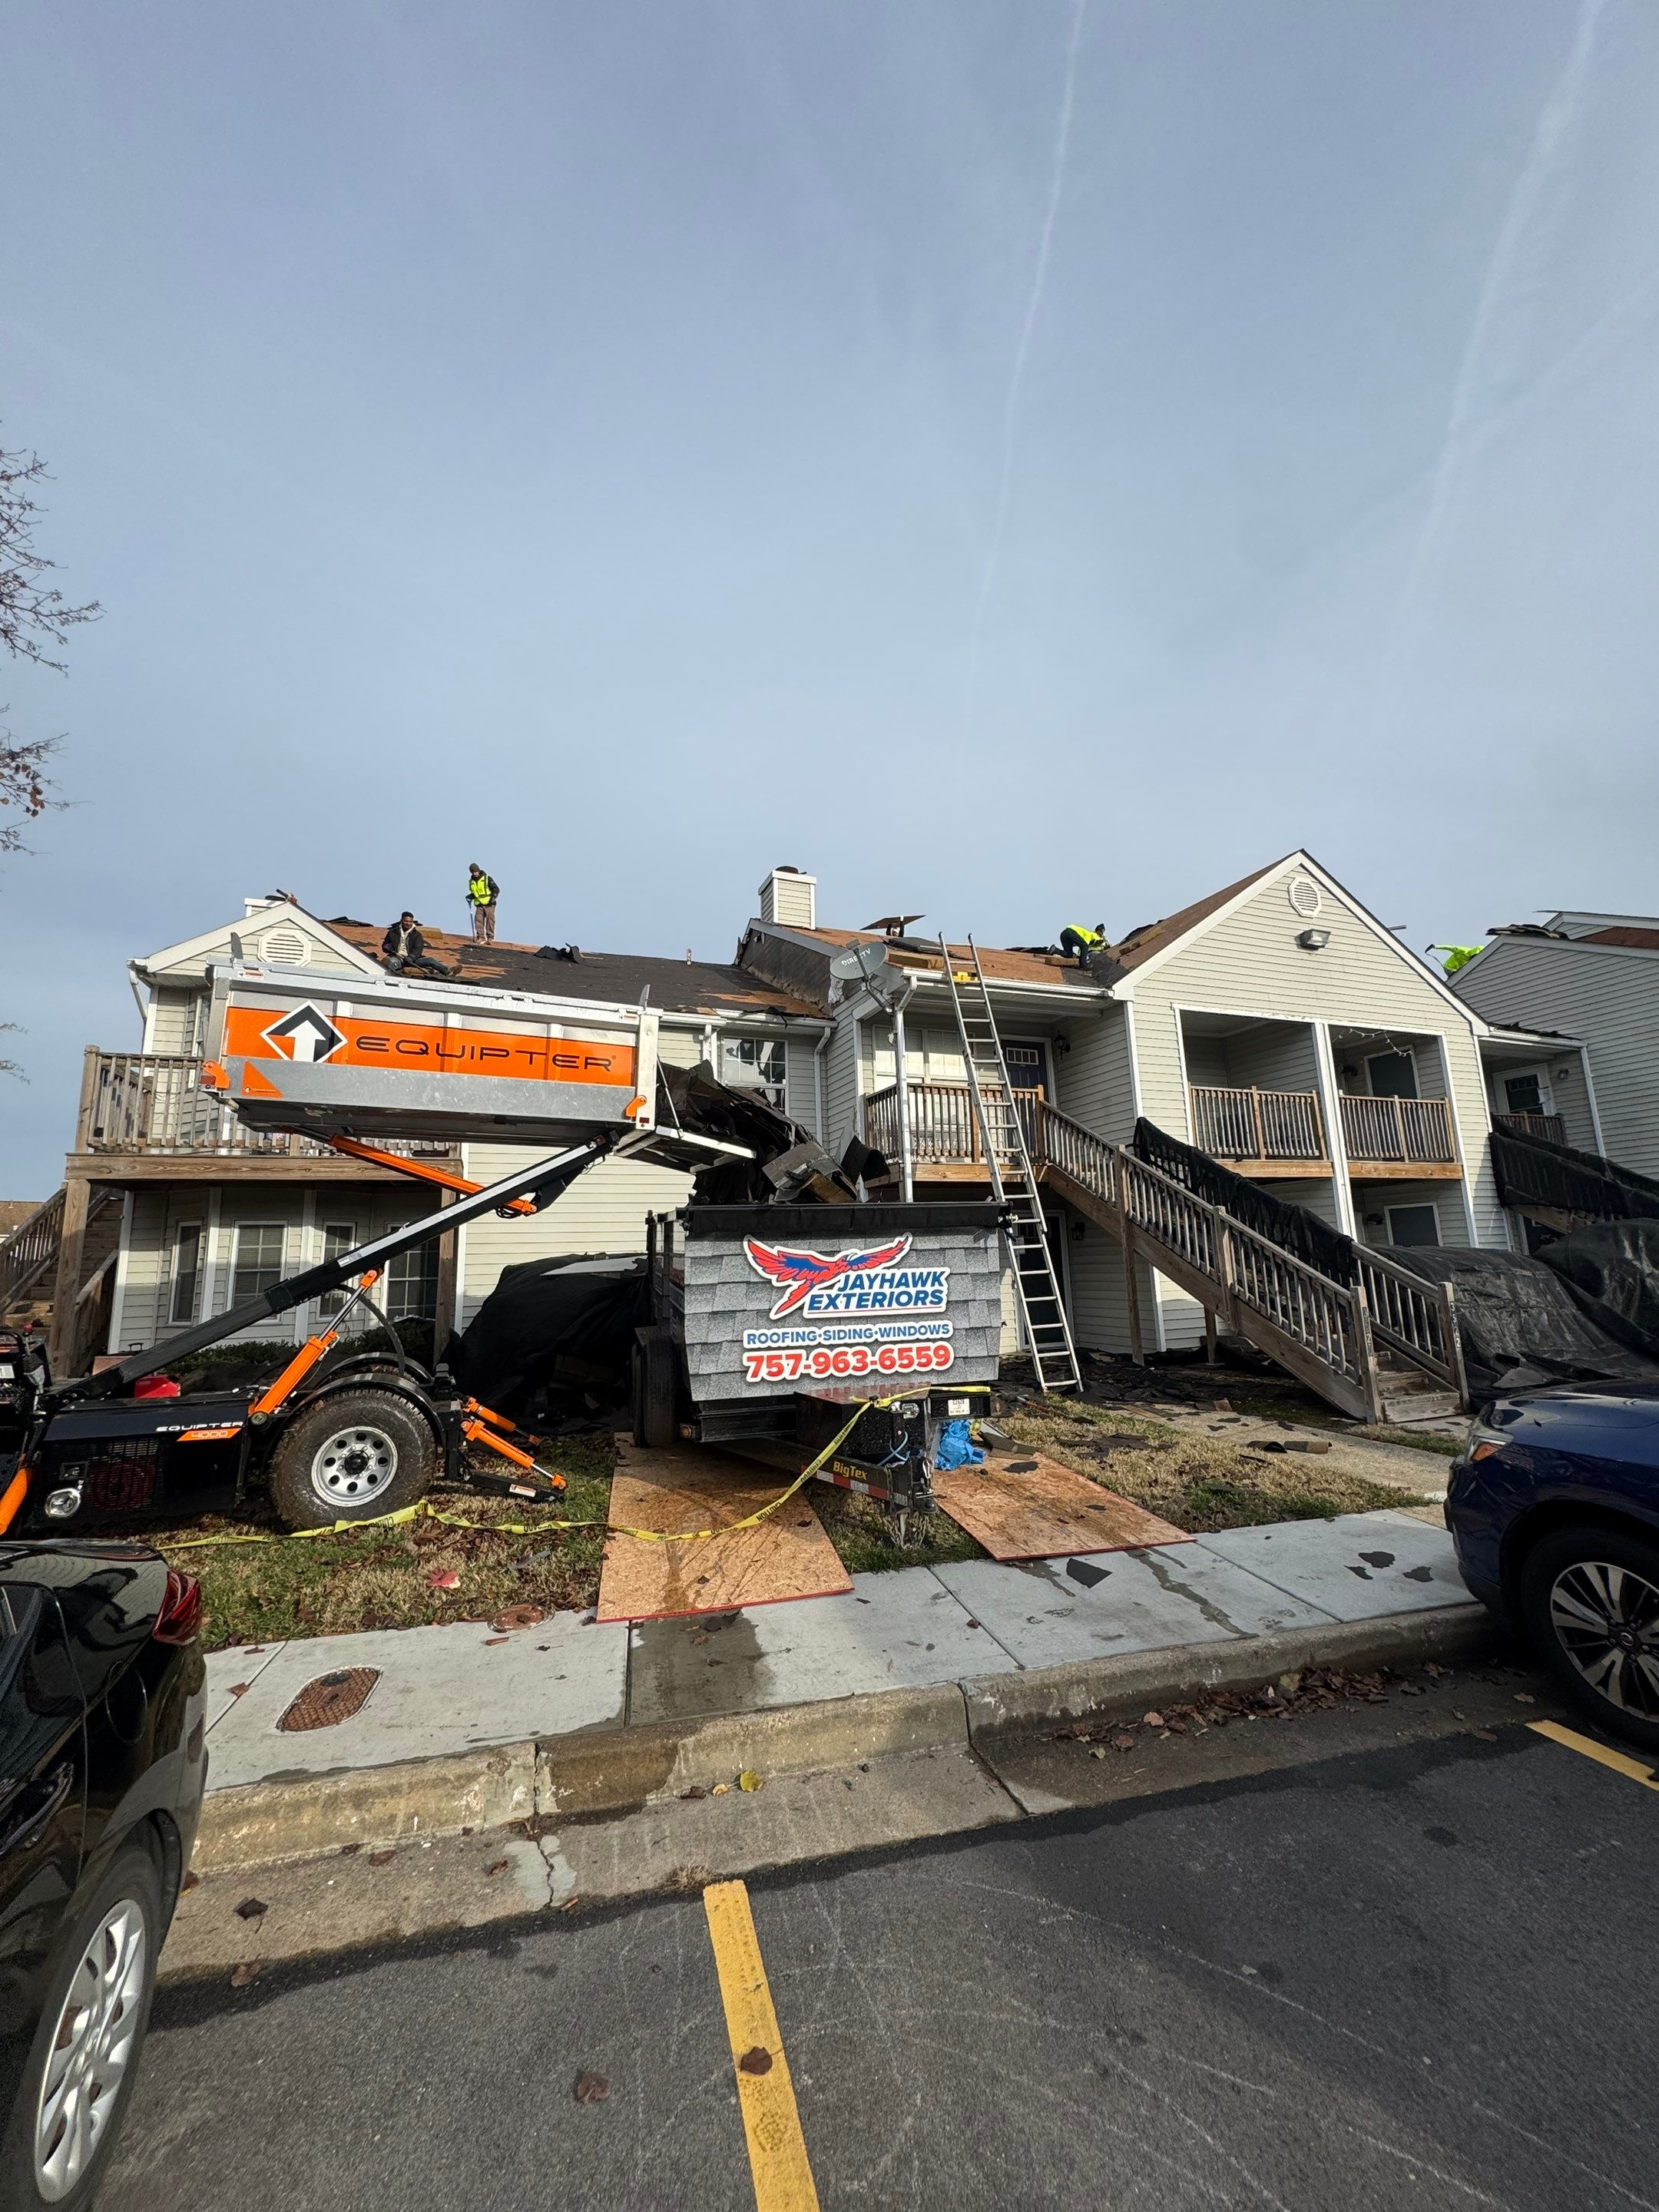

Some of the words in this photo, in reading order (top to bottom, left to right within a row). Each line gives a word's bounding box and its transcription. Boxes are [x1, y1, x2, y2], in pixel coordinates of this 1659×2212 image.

[837, 1270, 946, 1293] JAYHAWK
[807, 1289, 944, 1311] EXTERIORS
[747, 1330, 817, 1345] ROOFING
[823, 1327, 873, 1342] SIDING
[877, 1323, 950, 1338] WINDOWS
[747, 1344, 951, 1379] 757-963-6559
[156, 1421, 244, 1432] EQUIPTER
[190, 1430, 229, 1439] 4000
